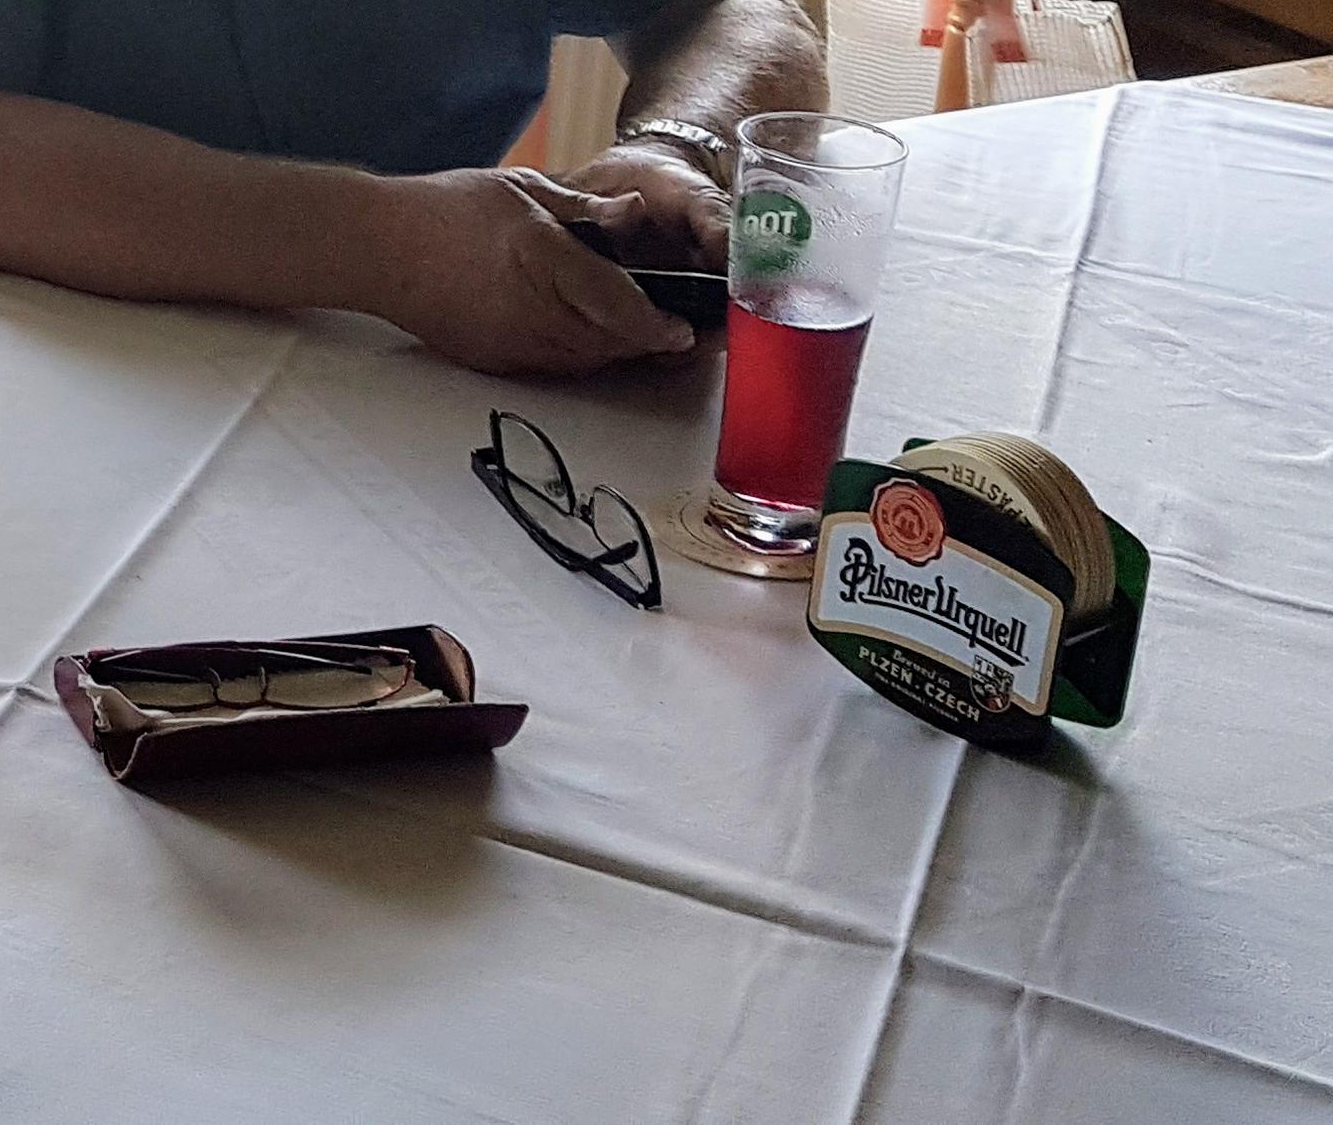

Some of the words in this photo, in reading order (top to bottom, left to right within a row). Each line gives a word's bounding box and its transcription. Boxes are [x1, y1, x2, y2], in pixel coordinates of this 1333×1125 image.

[839, 537, 935, 611] Pilsner
[933, 575, 1028, 659] Urquell
[892, 649, 937, 680] Brewed
[925, 682, 982, 723] CZECH
